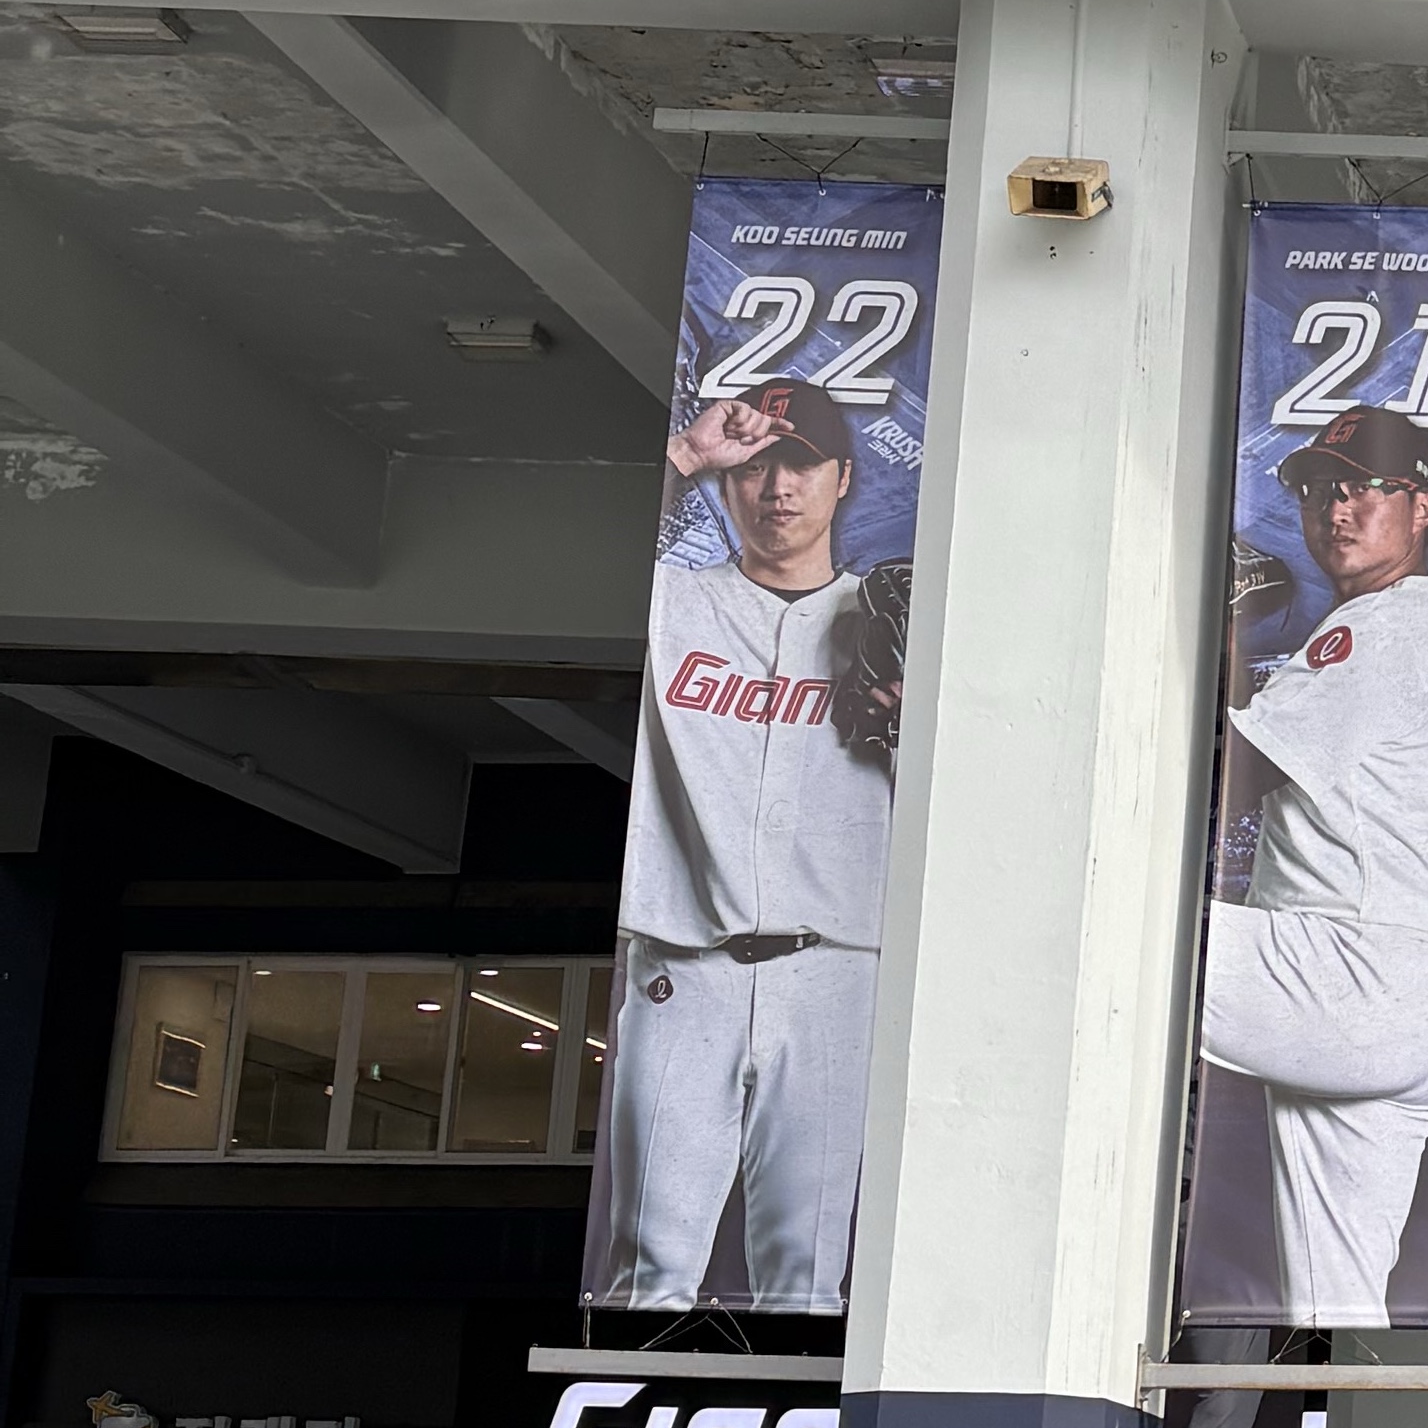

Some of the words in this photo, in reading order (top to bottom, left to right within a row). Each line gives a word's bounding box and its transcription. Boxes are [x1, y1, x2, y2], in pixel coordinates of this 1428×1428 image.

[731, 225, 780, 245] KOO
[782, 227, 858, 248] SEUNG
[860, 230, 908, 250] MIN
[1284, 250, 1345, 270] PARK
[1348, 251, 1380, 271] SE
[698, 275, 919, 405] 22
[665, 650, 839, 726] Gian
